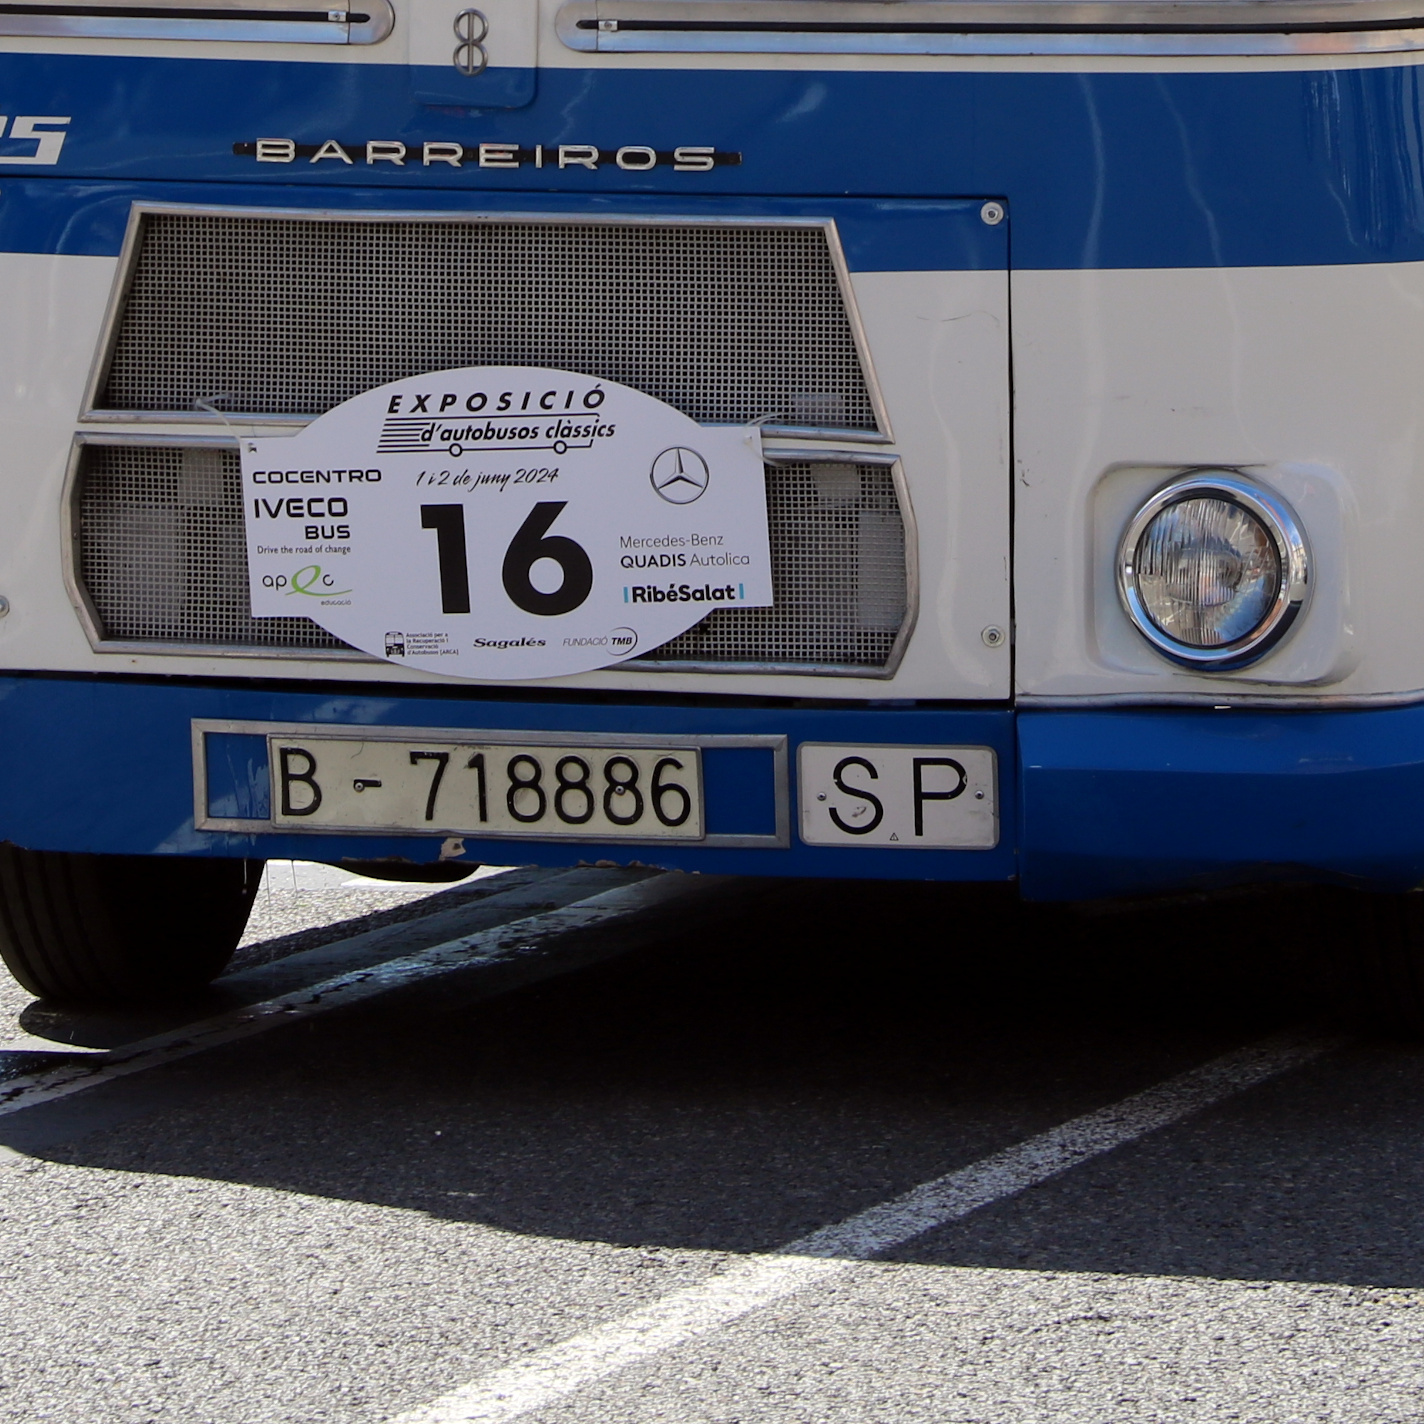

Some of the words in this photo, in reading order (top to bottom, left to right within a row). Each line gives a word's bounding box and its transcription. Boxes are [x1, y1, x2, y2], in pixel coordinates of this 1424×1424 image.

[256, 137, 716, 173] BARREIROS
[387, 383, 606, 414] EXPOSICIÓ
[420, 421, 540, 443] d'autobusos
[545, 419, 617, 439] clàssics
[253, 469, 382, 484] COCENTRO
[416, 470, 426, 487] 1
[438, 470, 450, 486] 2
[452, 468, 472, 486] de
[468, 472, 512, 493] juny
[513, 468, 560, 485] 2024
[254, 497, 348, 519] IVECO
[305, 525, 351, 540] BUS
[620, 533, 724, 549] Mercedes-Benz
[257, 545, 279, 554] Drive
[281, 545, 293, 554] the
[295, 545, 313, 554] road
[315, 545, 323, 554] of
[324, 545, 351, 555] change
[420, 500, 594, 617] 16
[620, 554, 687, 569] QUADIS
[689, 552, 750, 566] Autolica
[631, 583, 736, 604] RibéSalat
[473, 637, 547, 649] Sagalés
[562, 636, 609, 647] FUNDACIÓ
[611, 637, 633, 646] TMB
